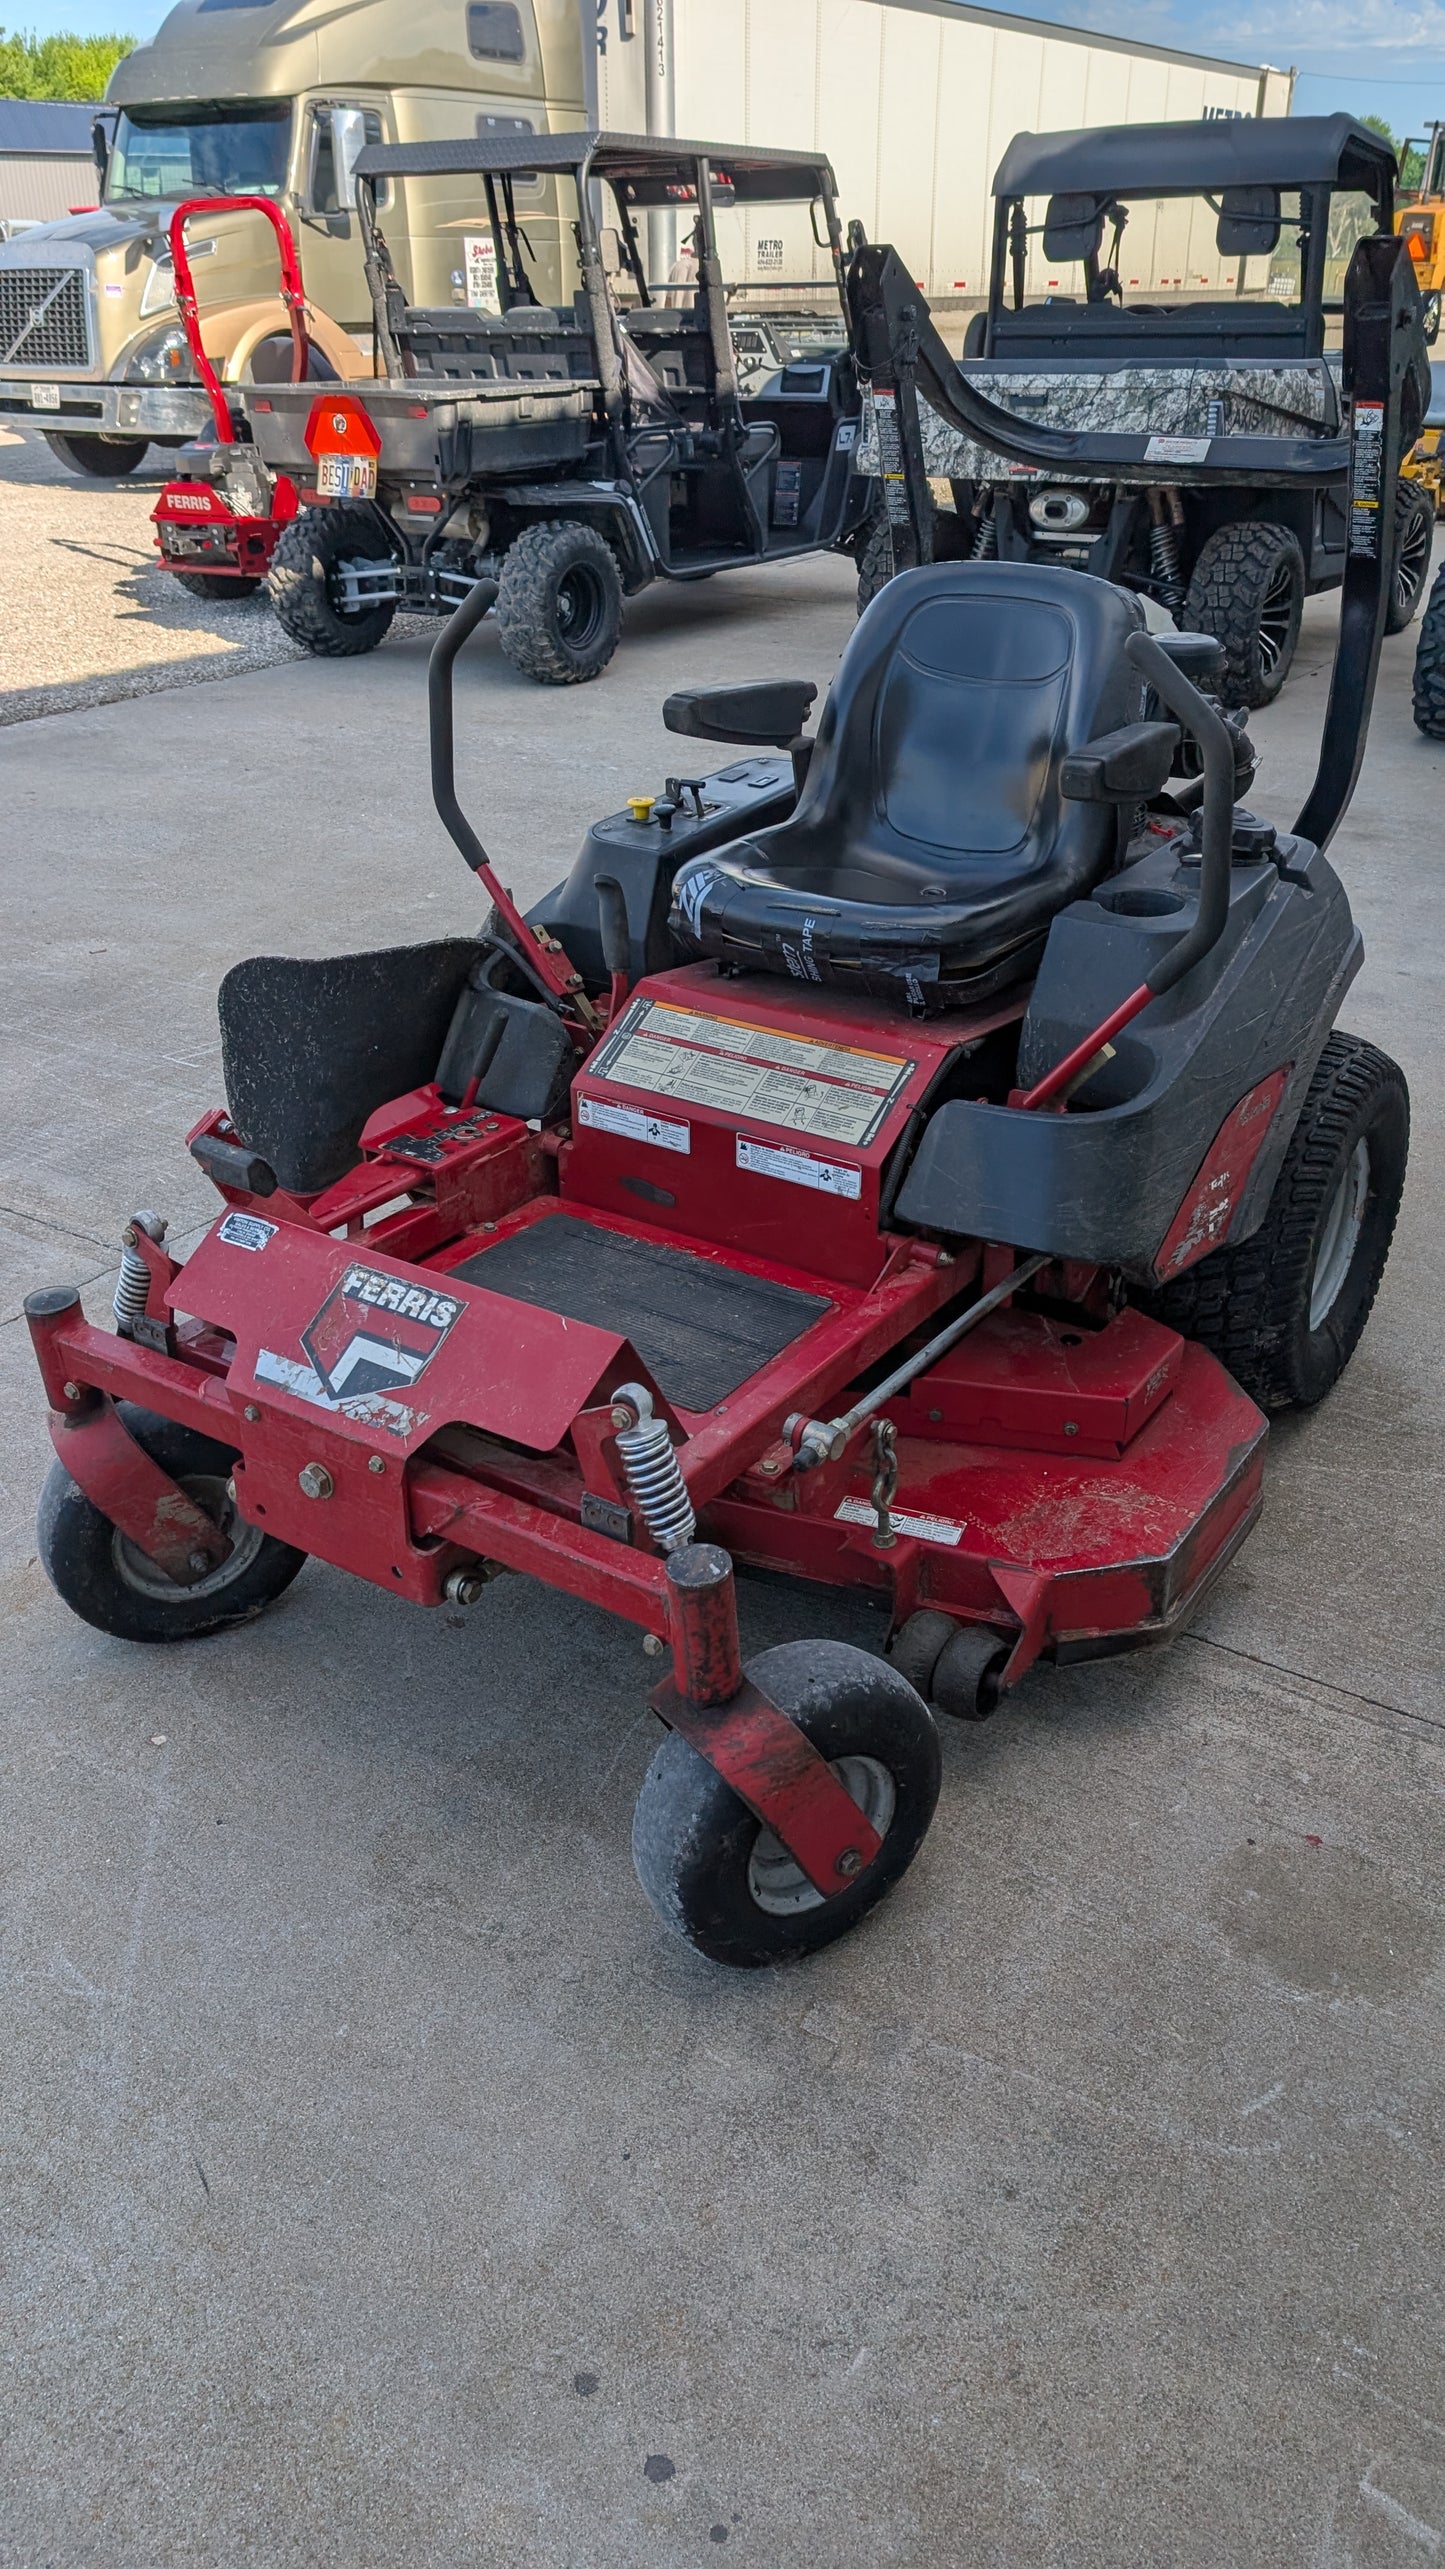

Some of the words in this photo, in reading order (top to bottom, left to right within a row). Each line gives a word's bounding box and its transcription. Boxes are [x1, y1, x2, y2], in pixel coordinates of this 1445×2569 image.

[757, 240, 783, 250] METRO
[354, 466, 376, 490] DAD
[166, 494, 211, 511] FERRIS
[803, 918, 816, 953] TAPE
[649, 1033, 672, 1042] DANGER
[724, 1052, 748, 1061] PELIGRO
[781, 1066, 806, 1076] DANGER
[850, 1082, 876, 1093] PELIGRO
[622, 1105, 645, 1115] DANGER
[785, 1147, 811, 1159] PELIGRO
[342, 1271, 457, 1328] FERRIS
[926, 1515, 955, 1526] PELIGRO
